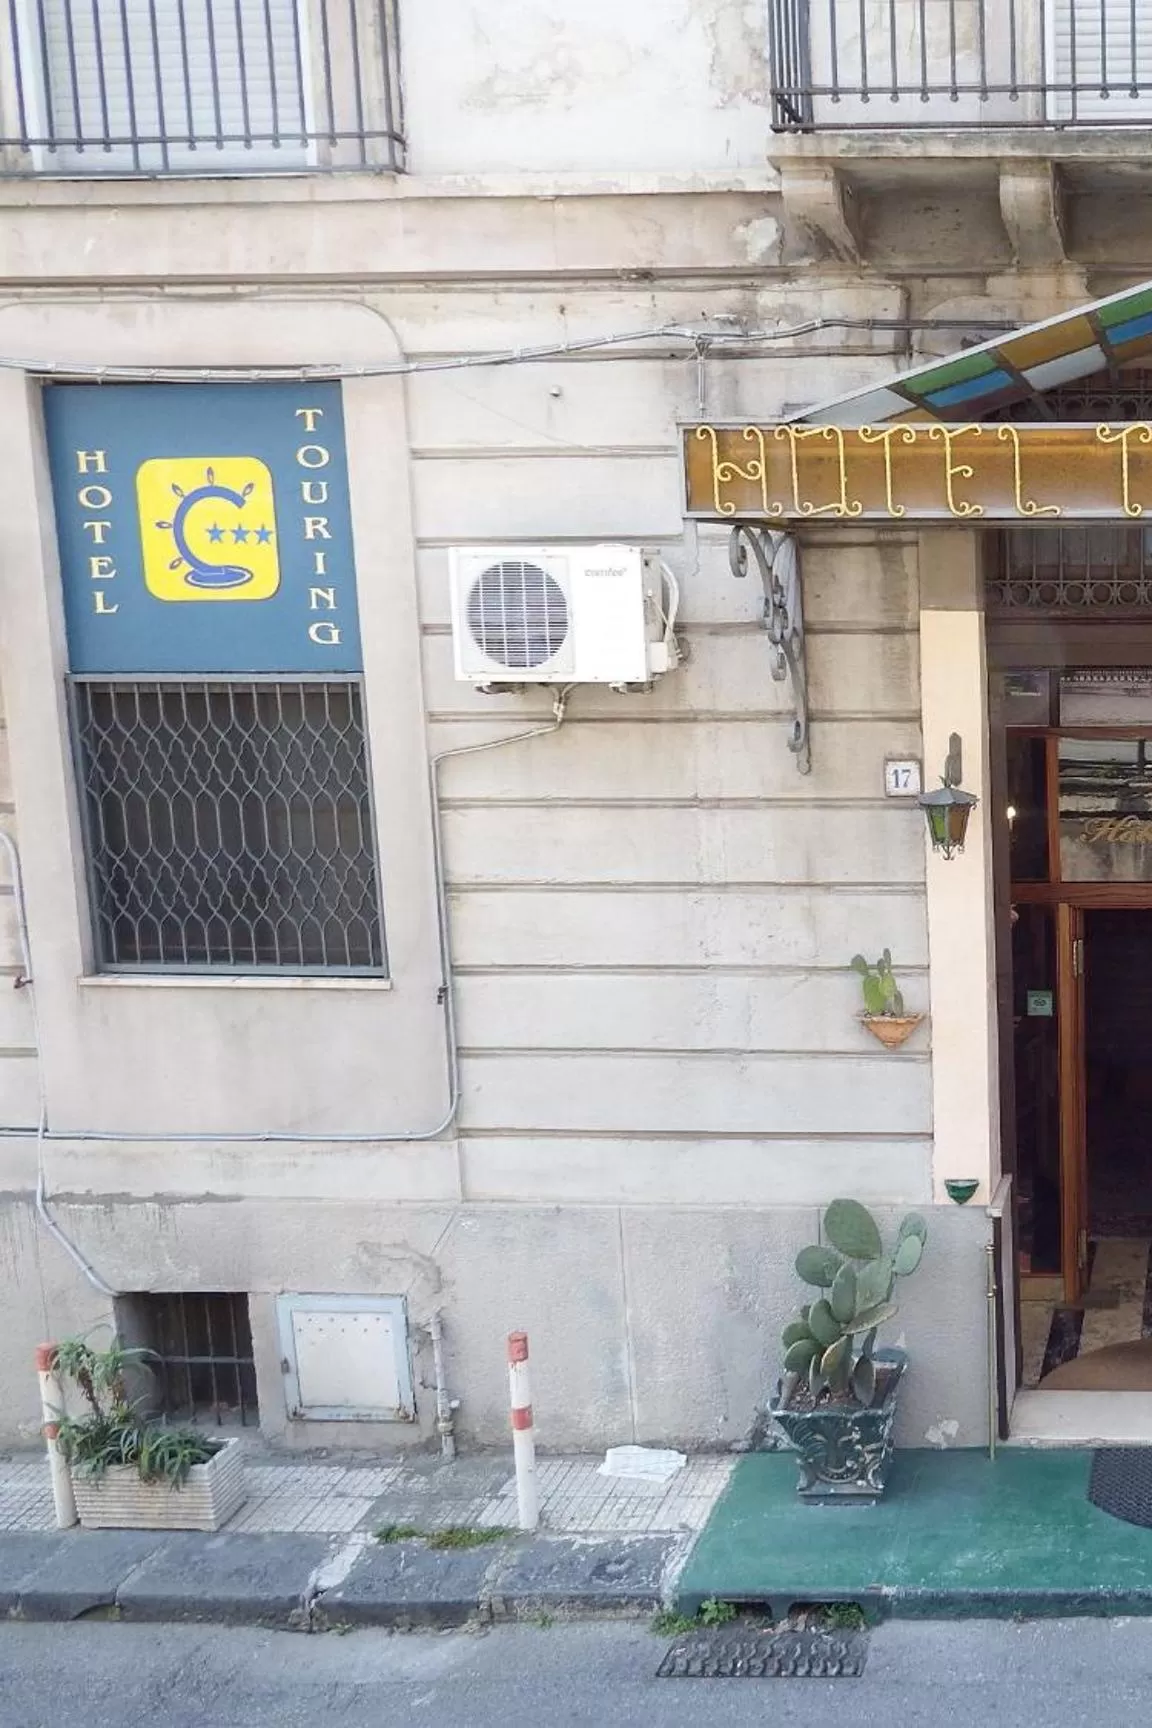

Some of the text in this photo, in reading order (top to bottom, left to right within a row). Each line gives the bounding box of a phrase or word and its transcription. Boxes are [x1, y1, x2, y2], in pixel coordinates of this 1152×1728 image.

[76, 450, 120, 615] HOTEL
[295, 408, 343, 645] TOURING
[696, 424, 1060, 516] HOTEL
[891, 768, 912, 789] 17
